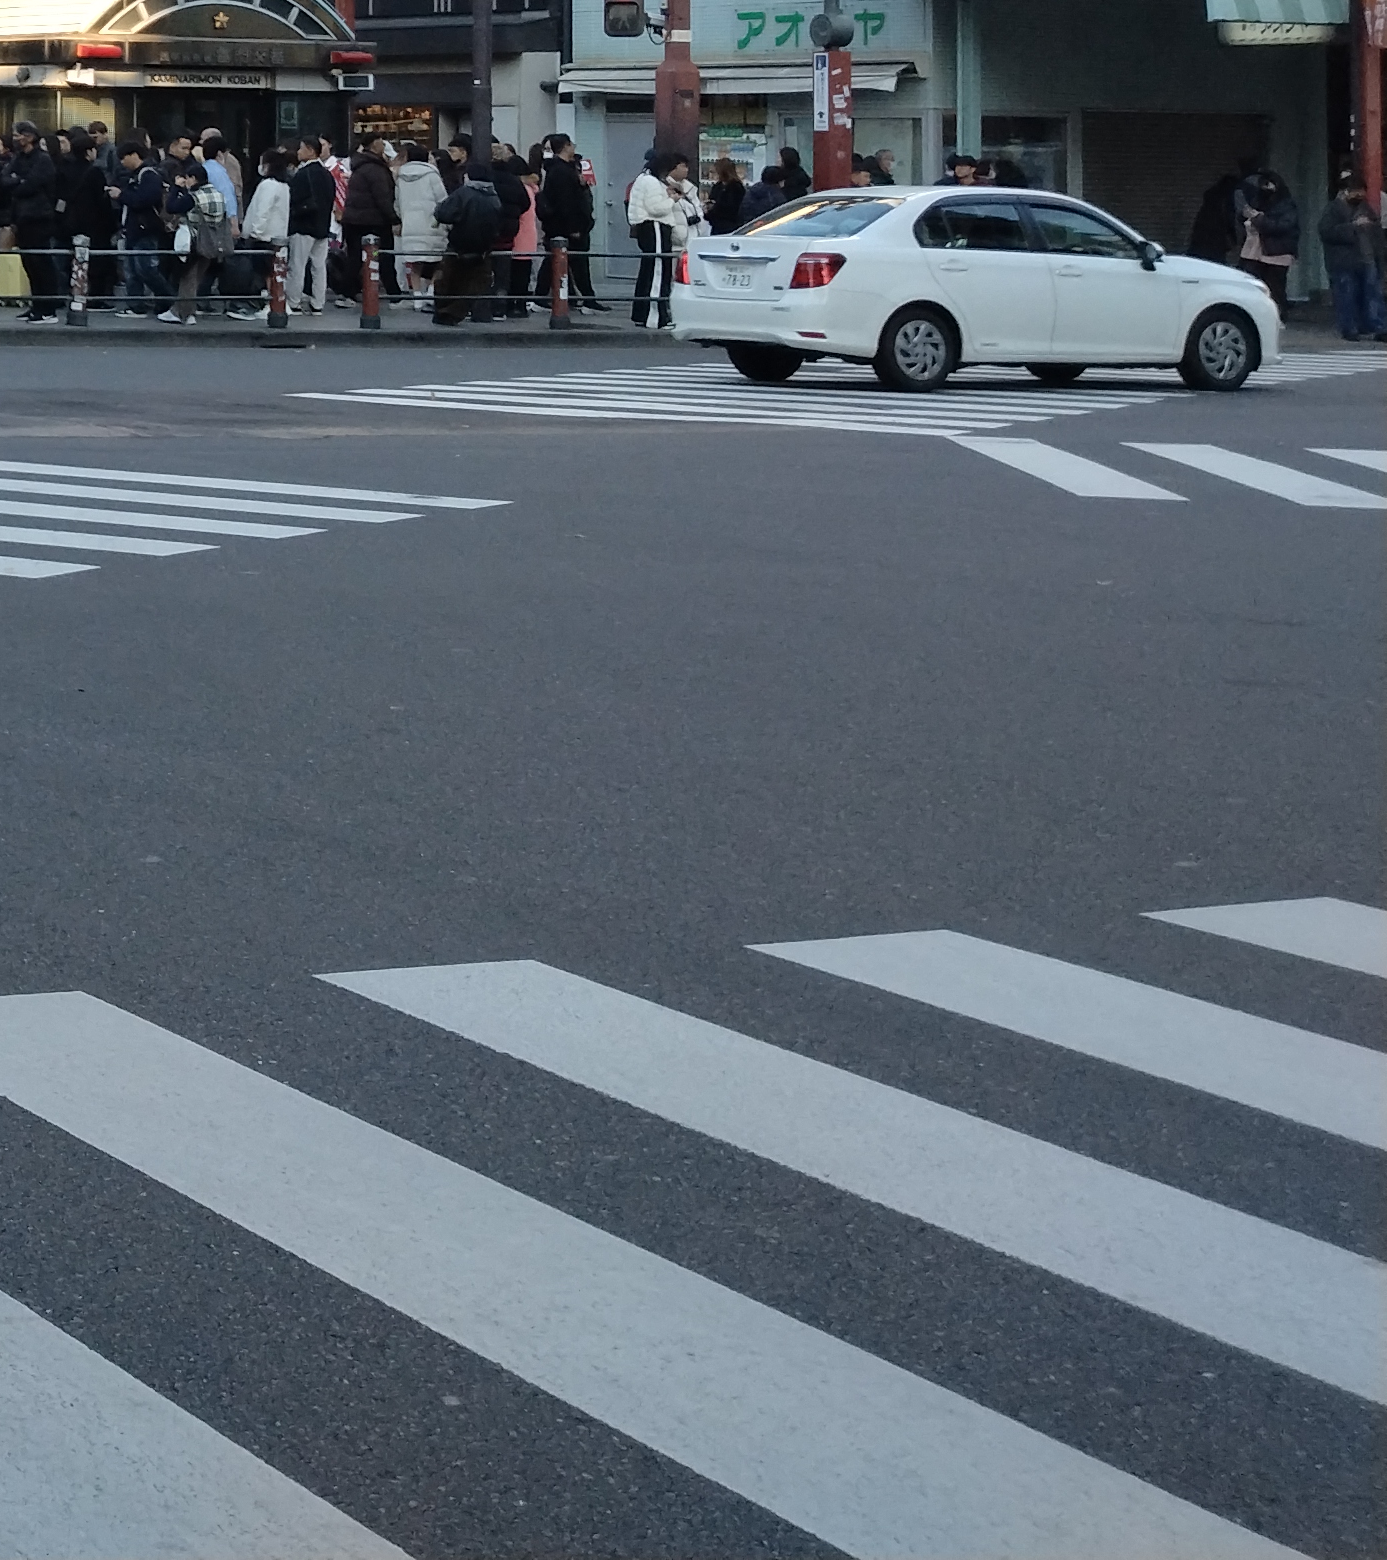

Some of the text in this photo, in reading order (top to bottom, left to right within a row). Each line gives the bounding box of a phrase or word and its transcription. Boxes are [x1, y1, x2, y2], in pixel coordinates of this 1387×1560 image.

[736, 10, 886, 50] アオヤ
[149, 73, 261, 86] KAMINARIMON KOBAN
